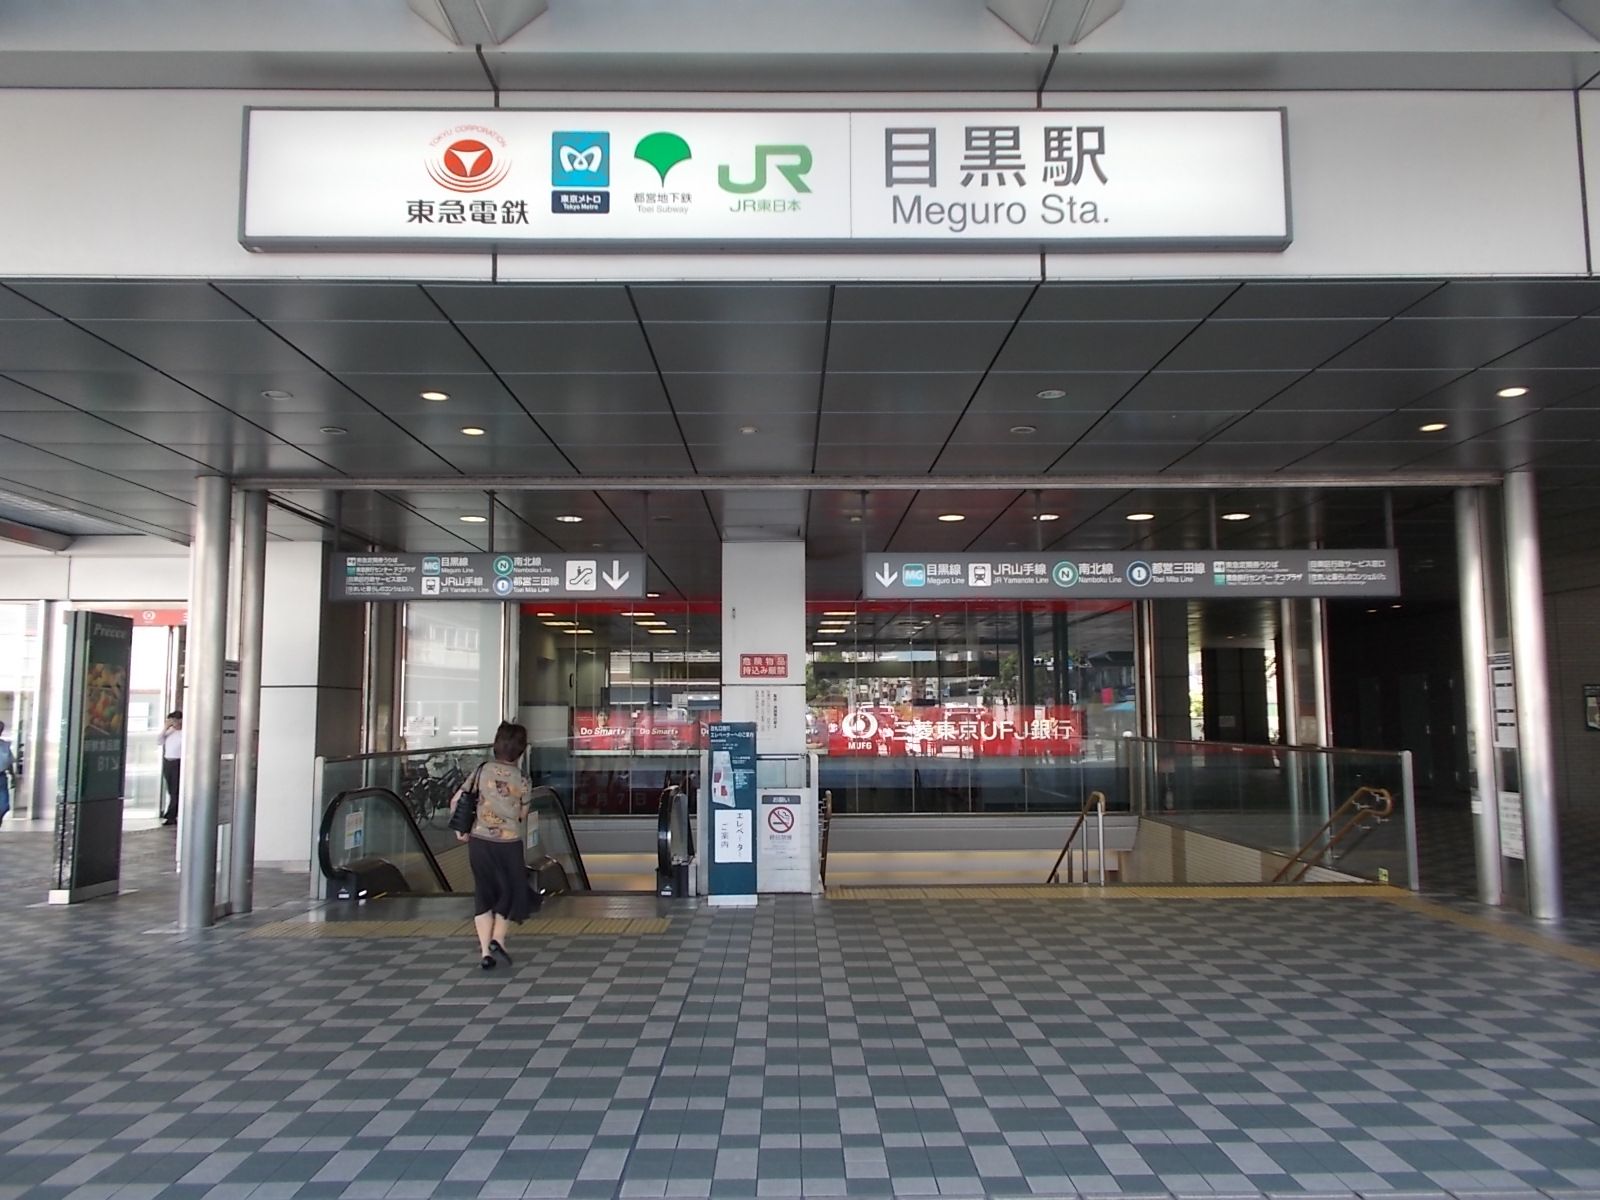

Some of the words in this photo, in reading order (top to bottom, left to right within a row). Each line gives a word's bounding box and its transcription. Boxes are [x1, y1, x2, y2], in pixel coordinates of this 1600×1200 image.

[429, 129, 453, 146] TOKYU
[455, 125, 508, 147] CORPORATION
[884, 125, 1109, 188] 目黒駅
[718, 144, 813, 194] JR
[560, 194, 602, 204] 東京メトロ
[633, 192, 692, 204] 都営地下鉄
[563, 203, 583, 211] Tokyo
[638, 205, 654, 214] Toei
[656, 205, 689, 215] Subway
[729, 199, 802, 213] JR東日本
[406, 199, 530, 225] 東急電鉄
[891, 194, 1027, 233] Meguro
[1041, 193, 1109, 224] Sta.
[424, 562, 438, 570] MG
[441, 557, 469, 566] 目黒線
[514, 557, 541, 566] 南北線
[927, 563, 961, 576] 目黒線
[993, 563, 1047, 575] JR山手線
[1078, 563, 1113, 575] 南北線
[1152, 562, 1206, 575] 都営三田線
[905, 570, 923, 580] MG
[441, 577, 483, 586] JR山手線
[514, 577, 559, 586] 都営三田線
[927, 577, 951, 586] Meguro
[580, 727, 593, 735] Do
[594, 727, 621, 736] Smart
[893, 719, 1073, 741] 三菱東京UFJ銀行
[848, 741, 872, 750] MUFG
